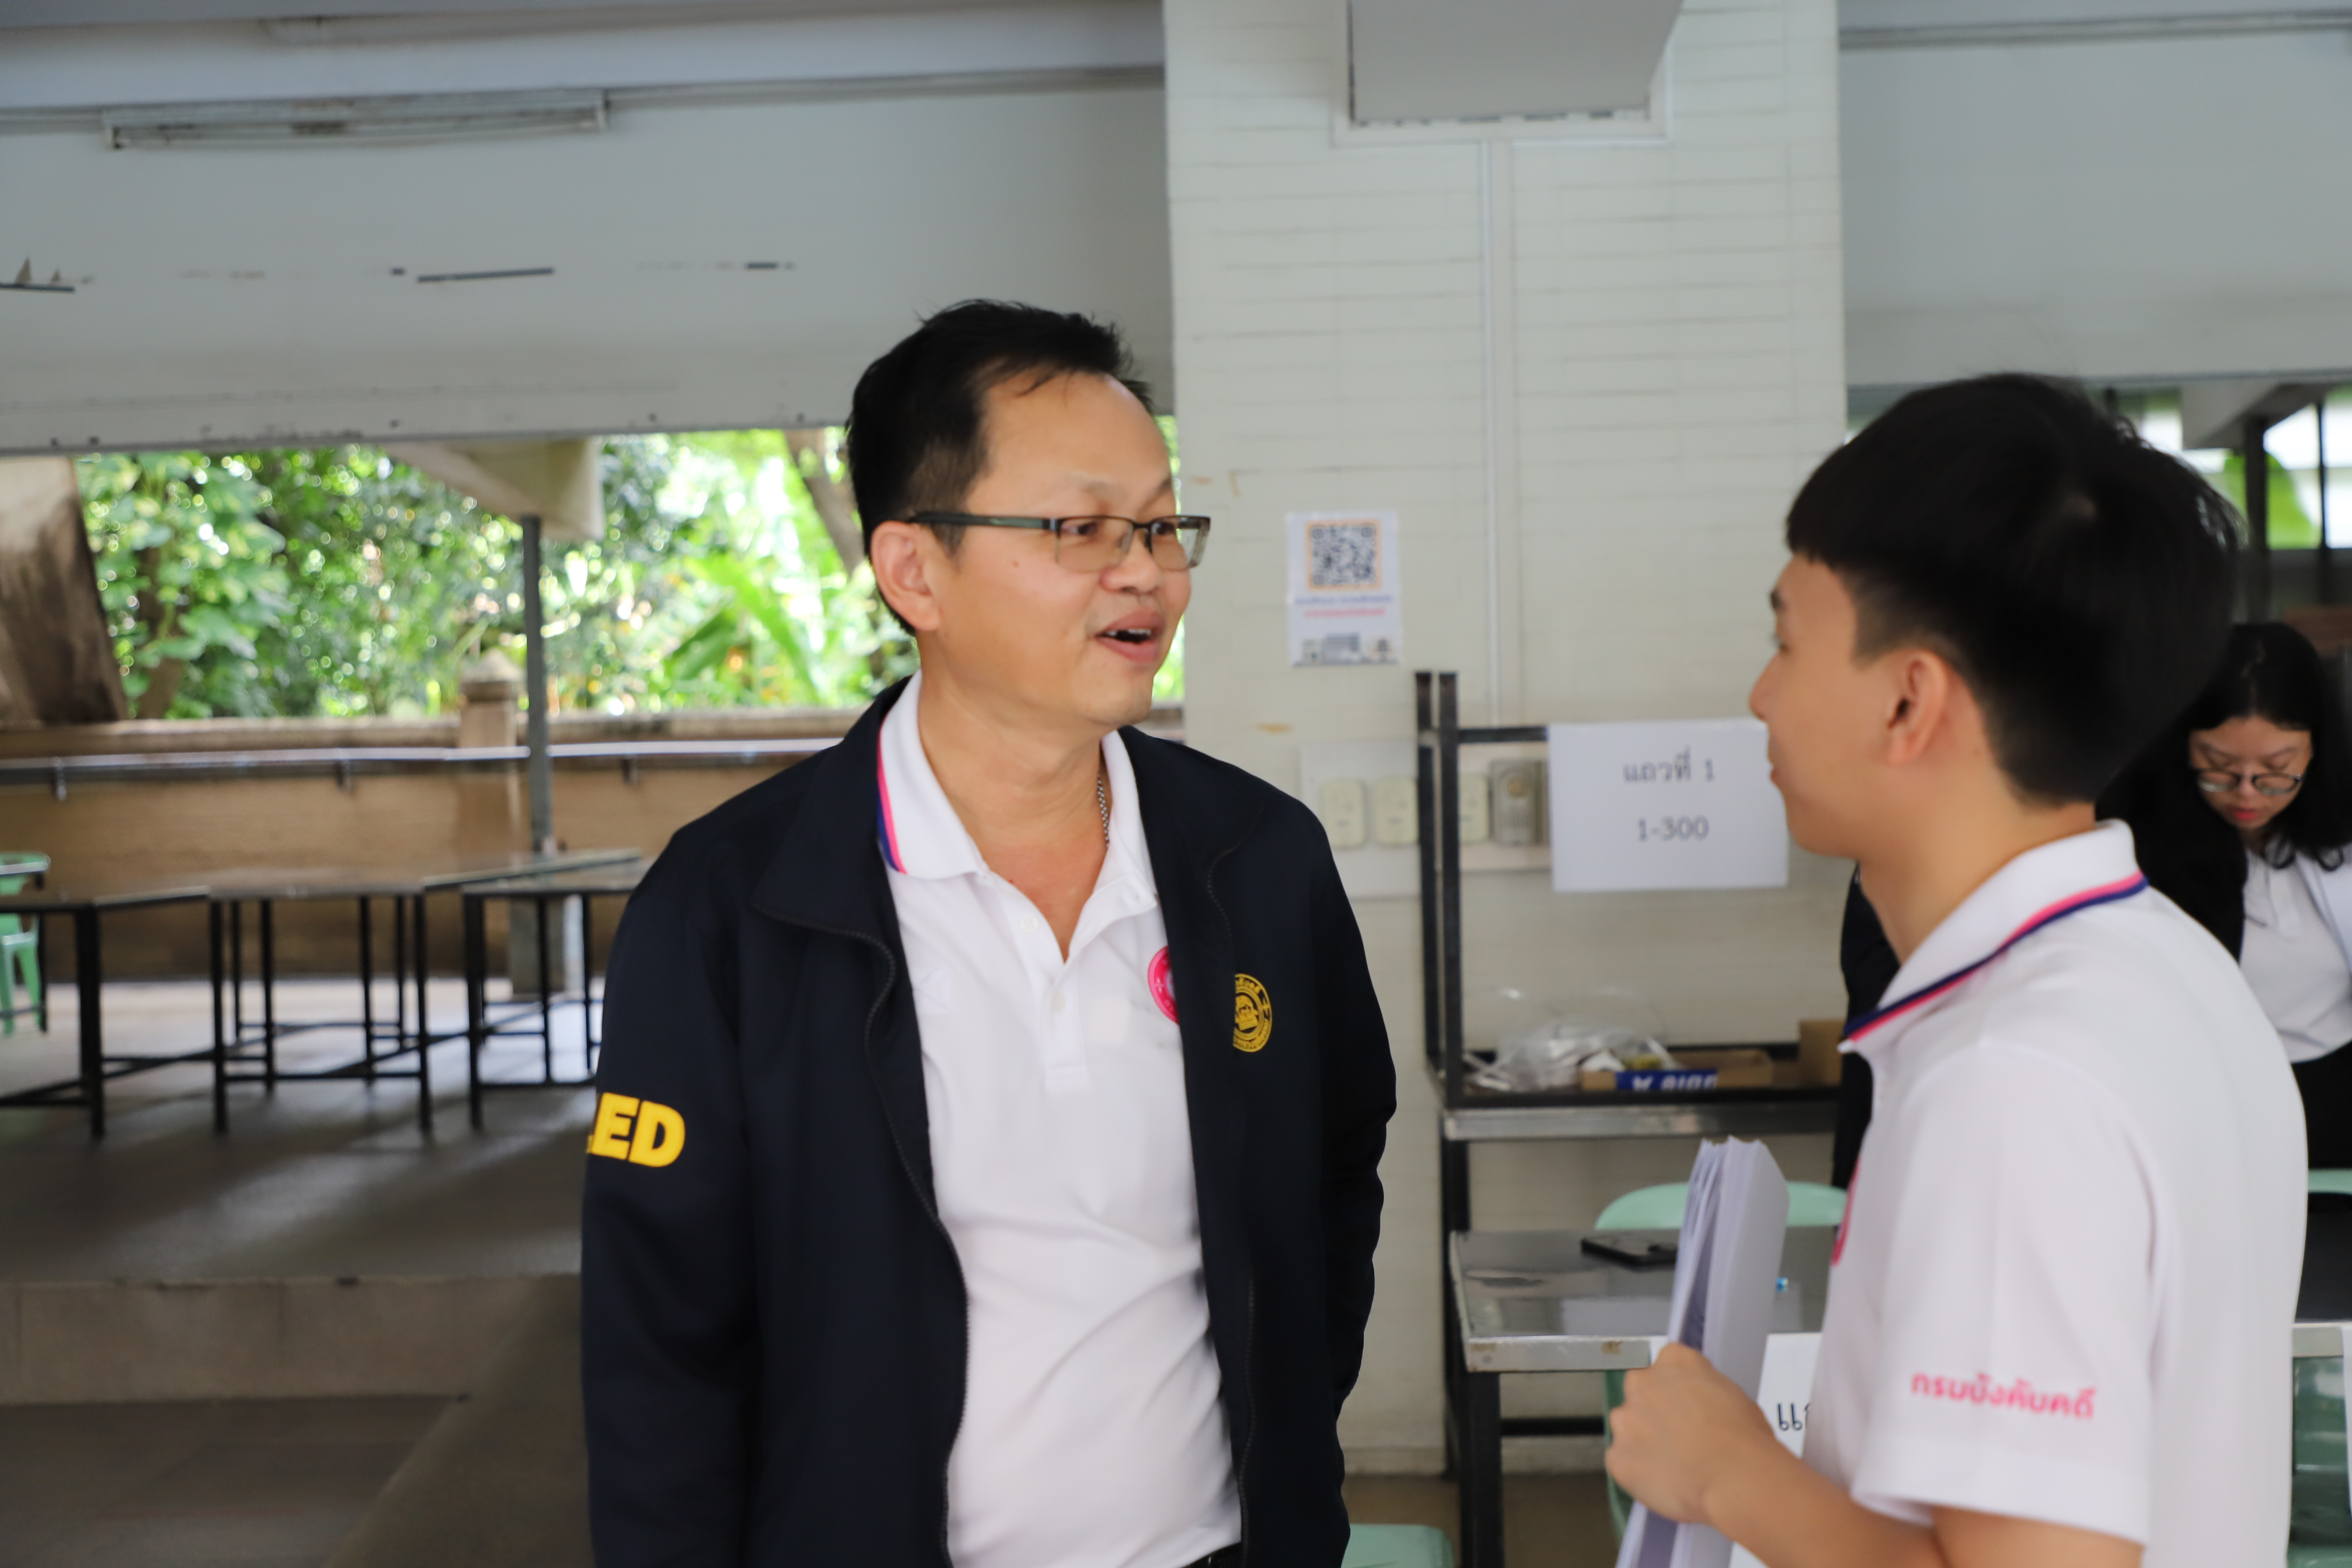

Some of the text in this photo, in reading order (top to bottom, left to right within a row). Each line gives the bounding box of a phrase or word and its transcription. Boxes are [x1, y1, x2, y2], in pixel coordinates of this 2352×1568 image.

[1622, 744, 1715, 782] แถวที่ 1
[1638, 815, 1709, 841] 1-300
[586, 1092, 685, 1167] ED
